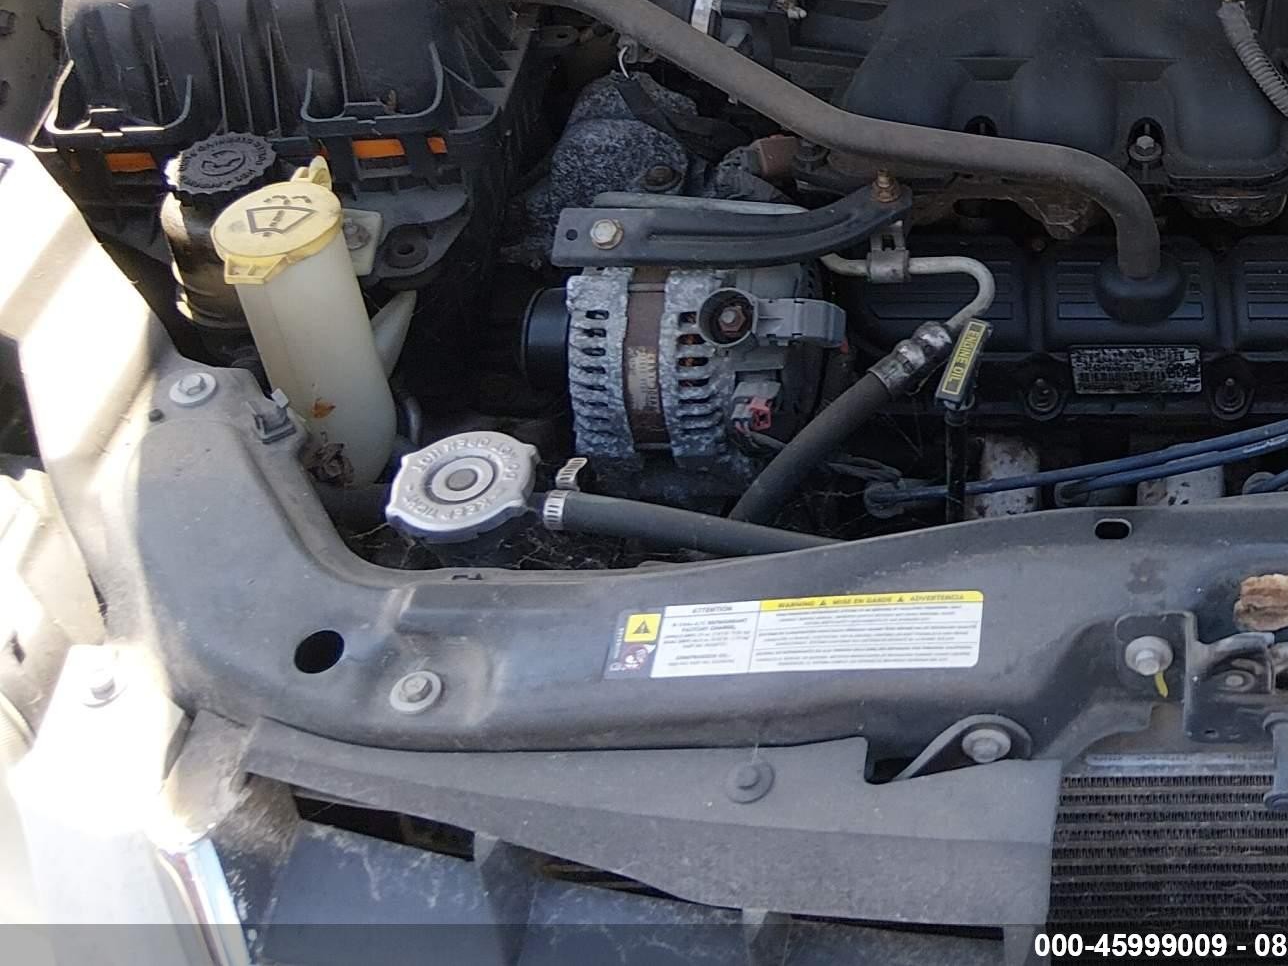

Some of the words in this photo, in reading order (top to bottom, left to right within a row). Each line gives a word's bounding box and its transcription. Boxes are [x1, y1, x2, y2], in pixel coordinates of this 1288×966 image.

[957, 330, 977, 364] ENGINE
[949, 366, 964, 382] OIL
[440, 496, 494, 521] KEEP
[909, 593, 965, 602] ADVERTENCIA
[692, 606, 733, 614] ATTENTION
